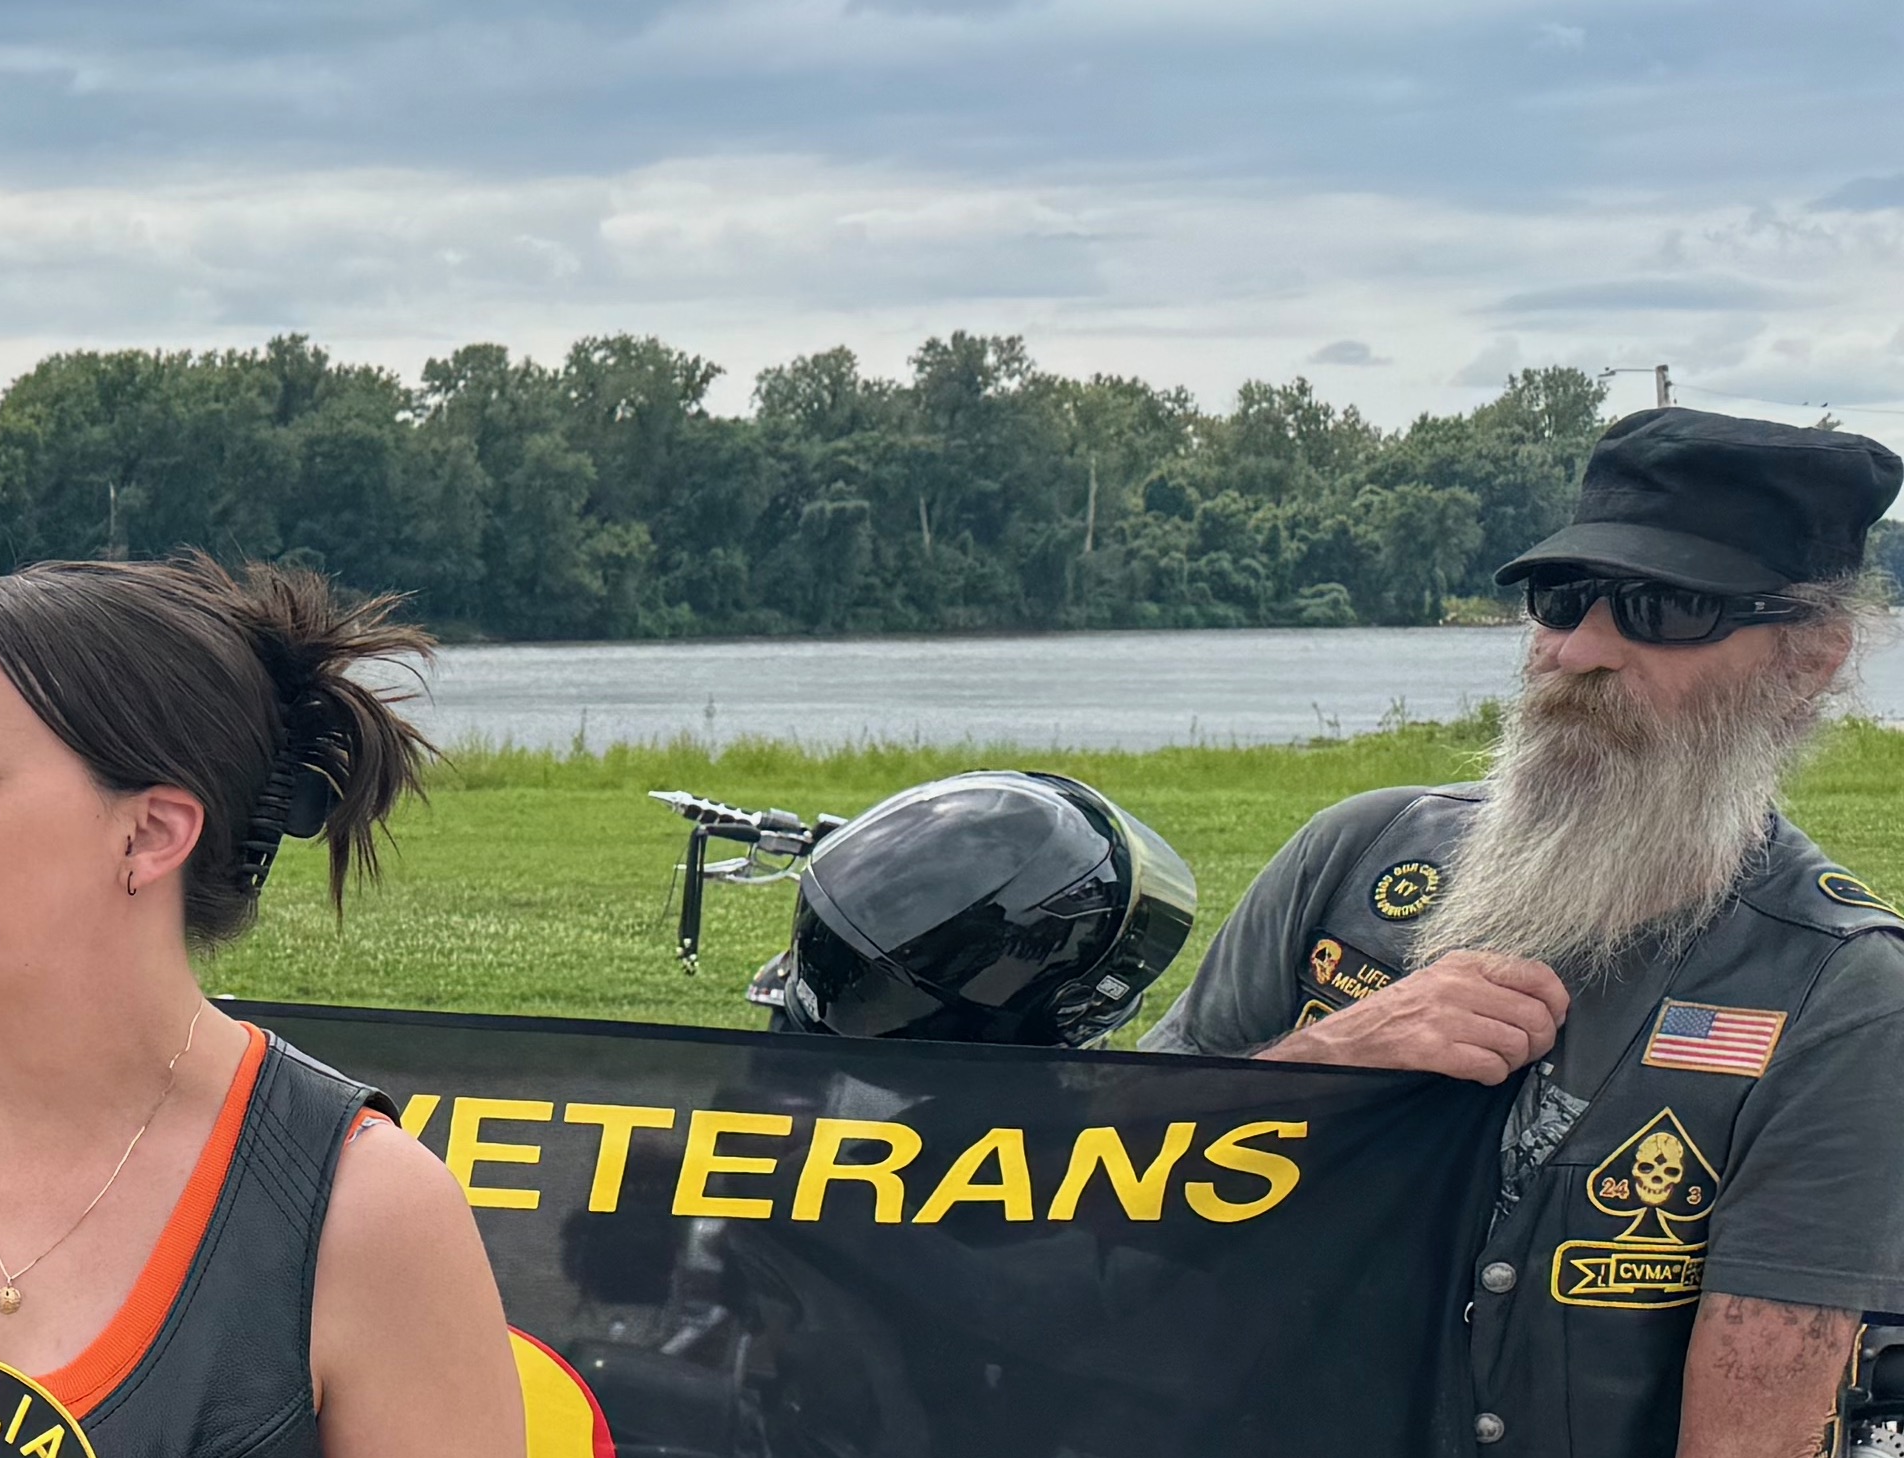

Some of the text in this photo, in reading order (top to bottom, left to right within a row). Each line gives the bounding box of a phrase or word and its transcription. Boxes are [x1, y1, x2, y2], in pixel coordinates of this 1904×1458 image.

[1357, 964, 1391, 988] LIFE
[1600, 1177, 1630, 1199] 24
[1686, 1186, 1702, 1205] 3
